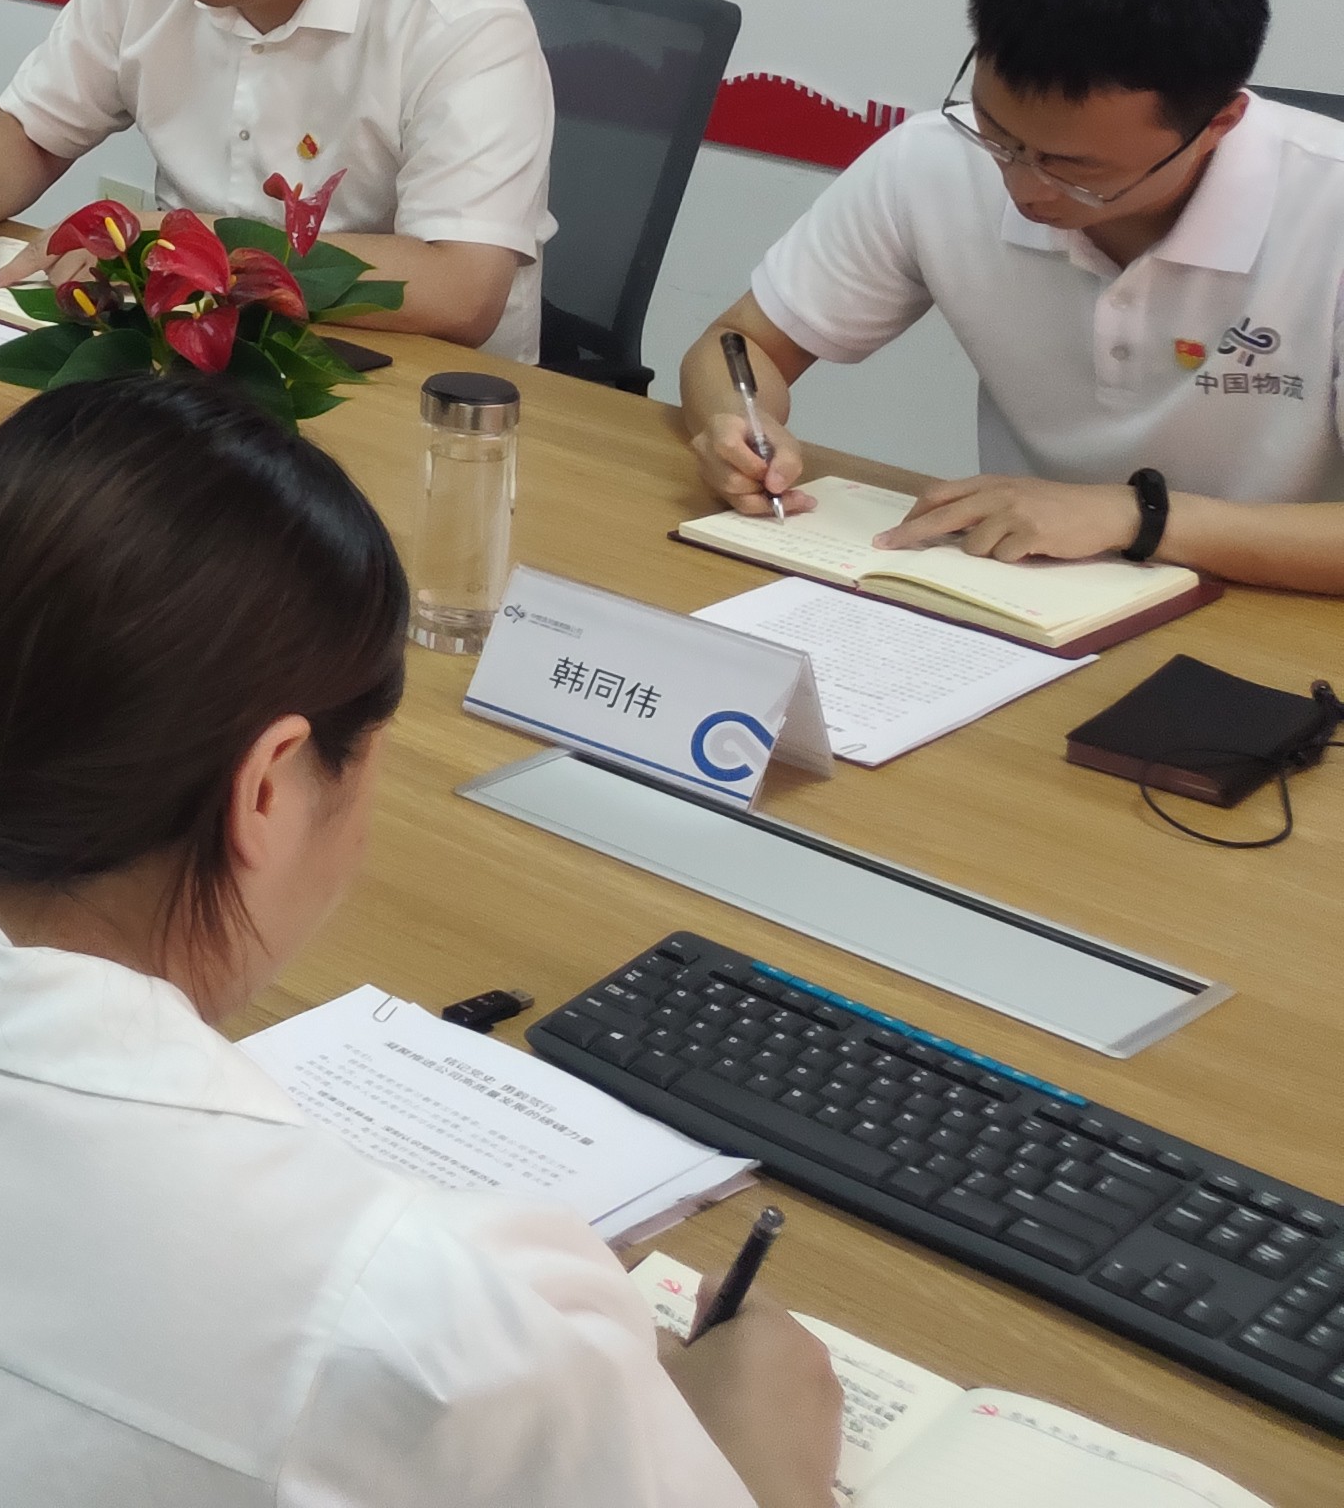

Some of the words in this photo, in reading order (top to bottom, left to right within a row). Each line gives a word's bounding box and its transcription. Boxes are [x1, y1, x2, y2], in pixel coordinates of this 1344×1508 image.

[1194, 370, 1304, 400] 中国物流
[548, 656, 662, 720] 韩同伟
